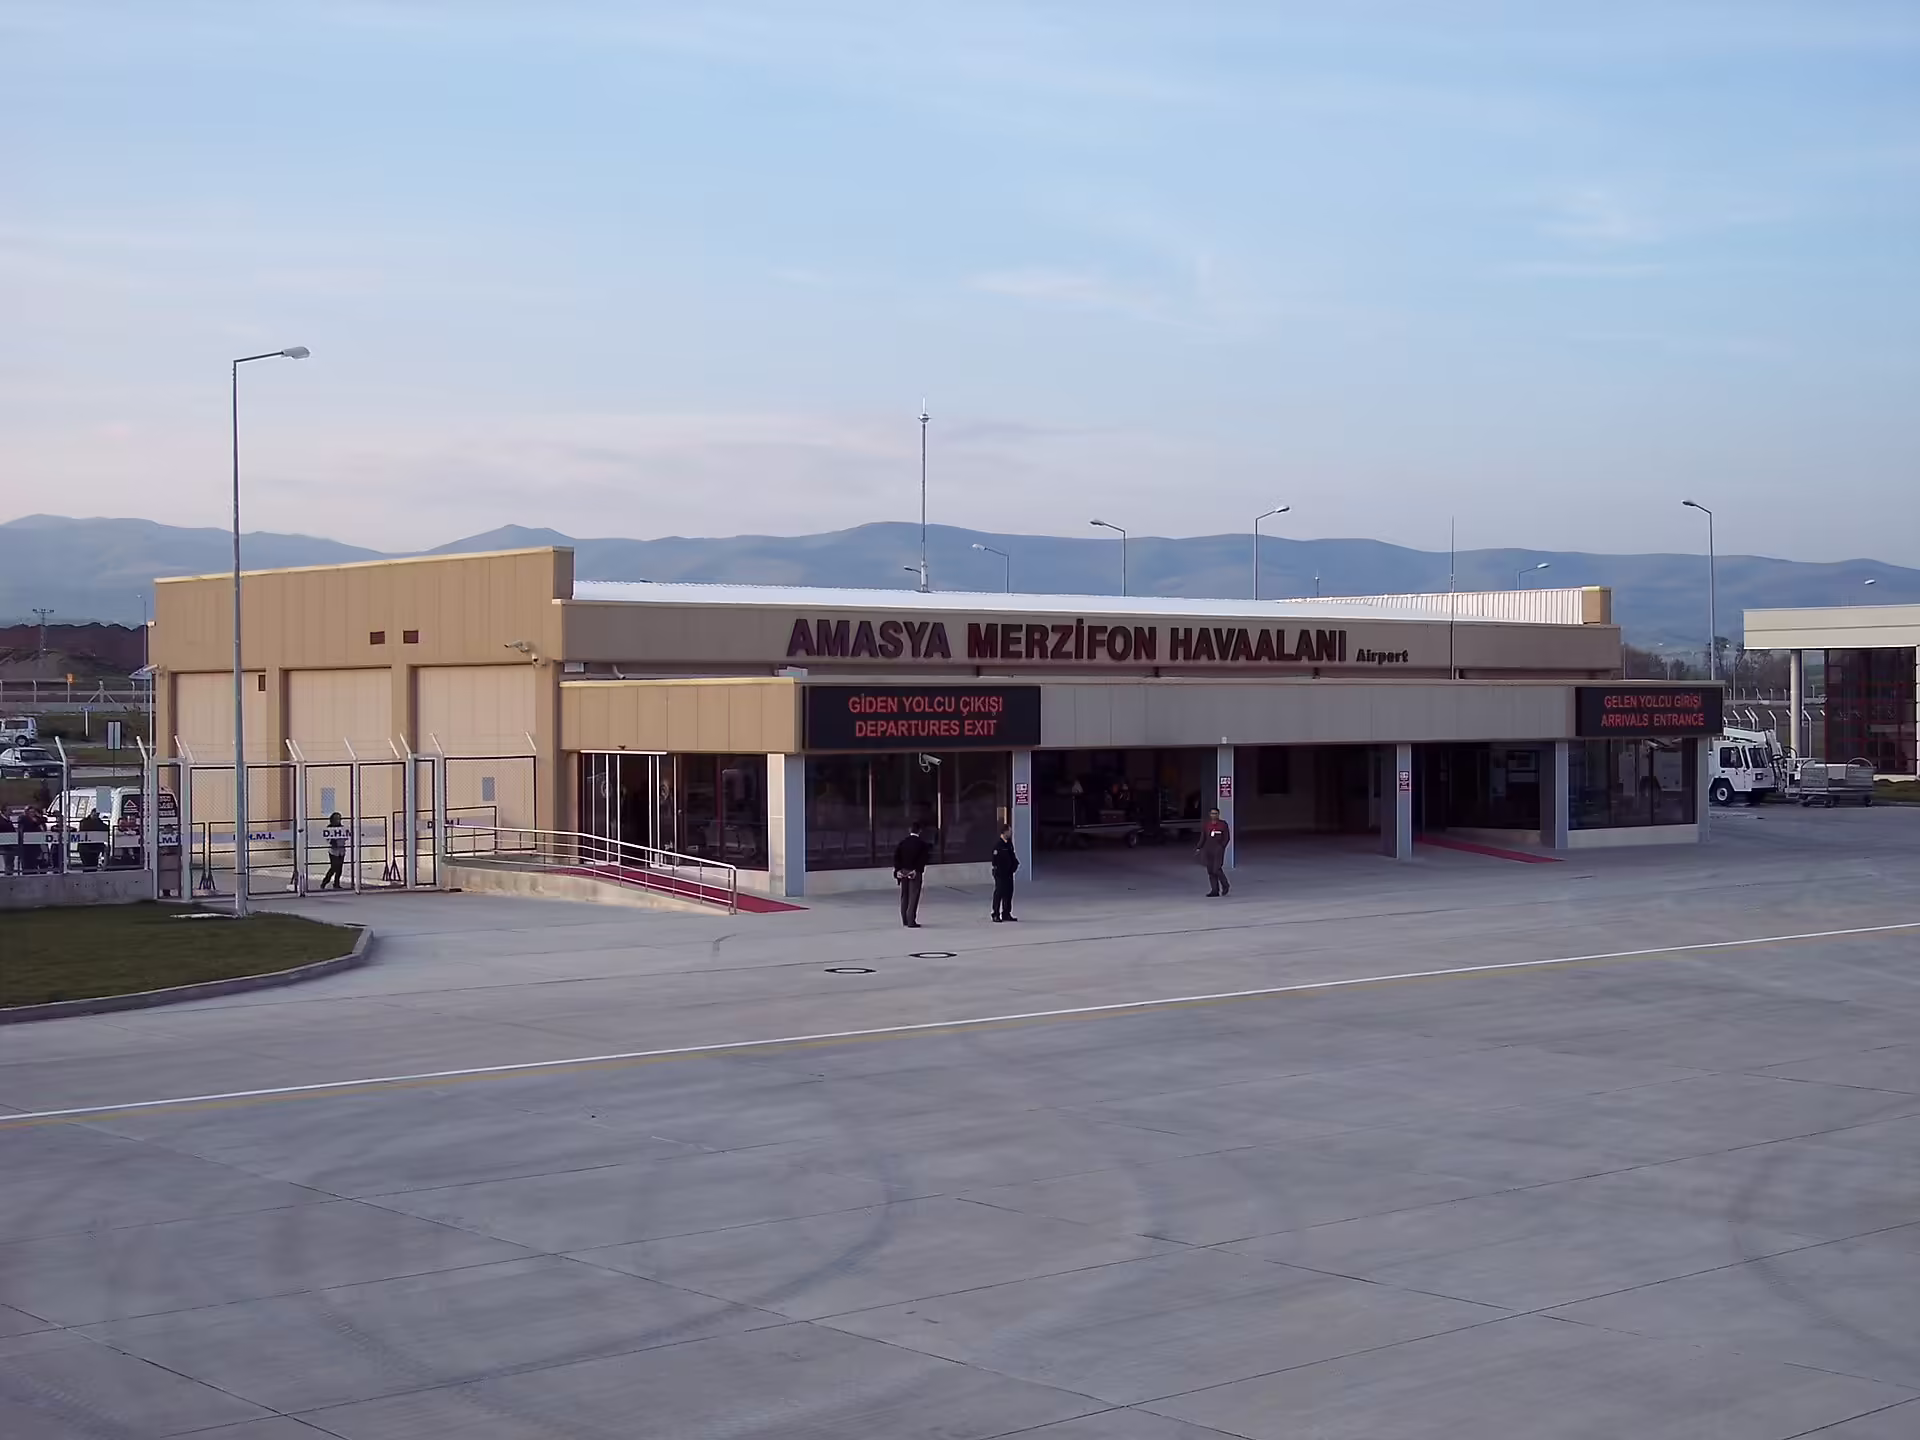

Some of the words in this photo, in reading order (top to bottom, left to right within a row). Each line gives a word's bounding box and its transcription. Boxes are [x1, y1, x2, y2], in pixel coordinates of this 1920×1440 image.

[786, 618, 952, 659] AMASYA
[966, 618, 1157, 661] MERZİFON
[1169, 626, 1347, 662] HAVAALANI
[1356, 648, 1409, 665] Airport
[848, 693, 898, 713] GİDEN
[902, 696, 955, 713] YOLCU
[959, 696, 1003, 716] ÇIKIŞI
[1604, 695, 1637, 709] GELEN
[1639, 695, 1672, 708] YOLCU
[855, 719, 960, 737] DEPARTURES
[964, 719, 998, 736] EXIT
[1601, 713, 1649, 727] ARRIVALS
[1653, 713, 1705, 727] ENTRANCE
